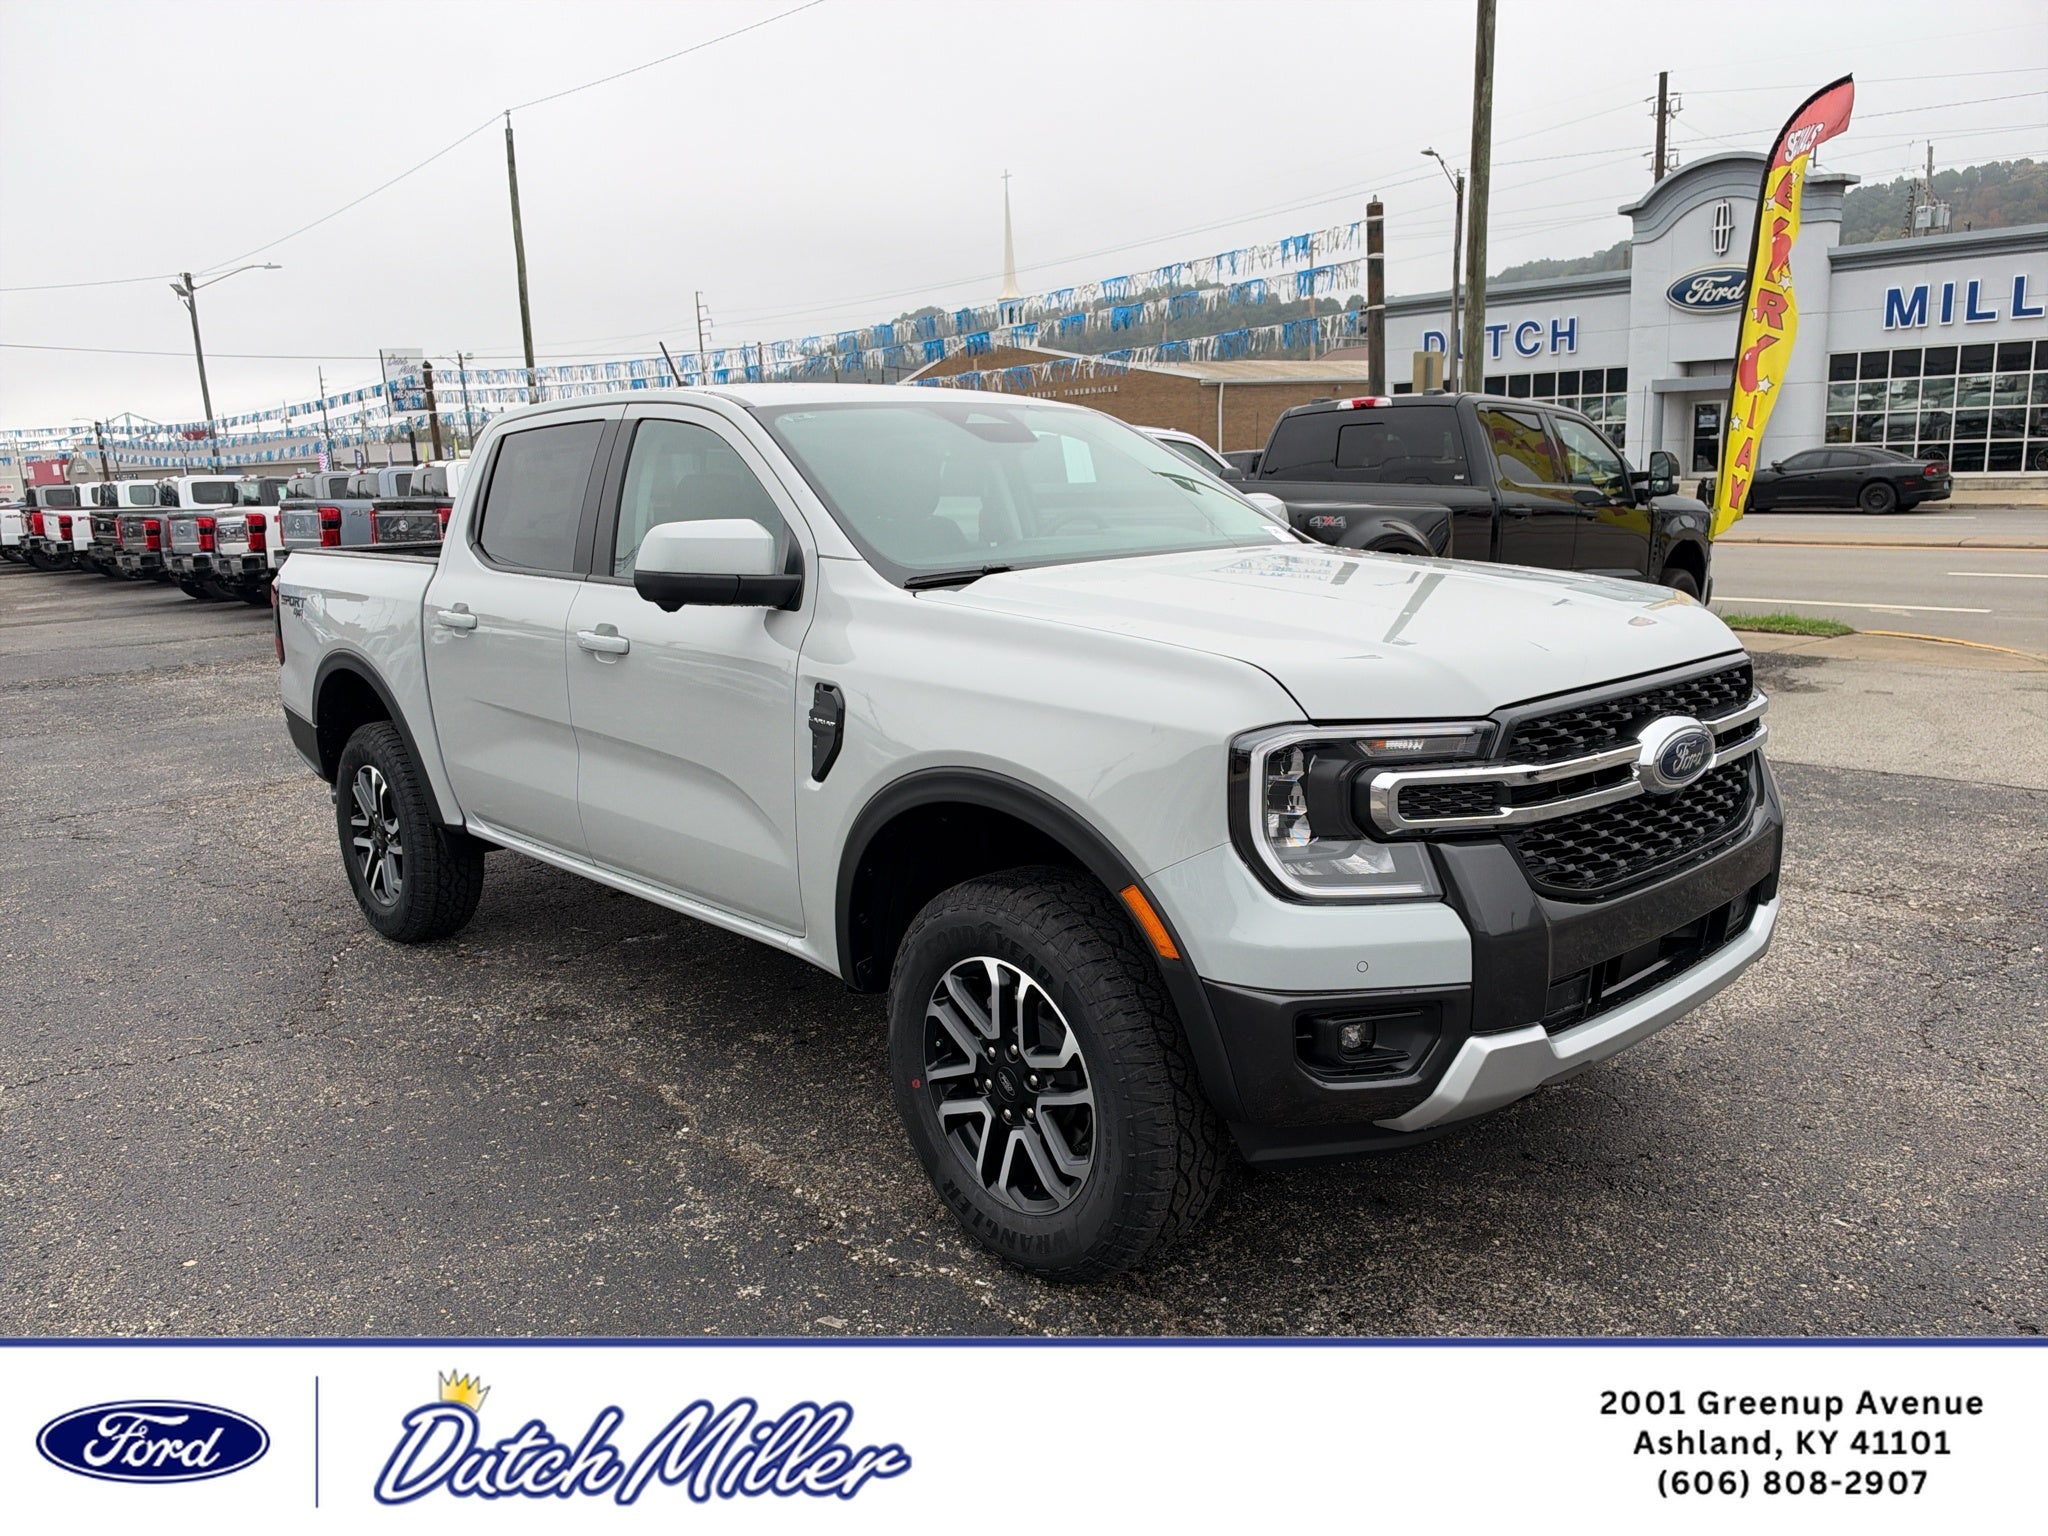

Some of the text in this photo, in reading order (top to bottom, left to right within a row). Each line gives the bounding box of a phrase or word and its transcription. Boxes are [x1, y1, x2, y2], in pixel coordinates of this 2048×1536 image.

[1685, 275, 1746, 304] Ford
[1884, 274, 2045, 330] MILL
[1424, 316, 1578, 361] DTCH
[1064, 385, 1119, 396] TABERNACLE
[281, 594, 307, 608] SPORT
[1672, 740, 1705, 774] Ford
